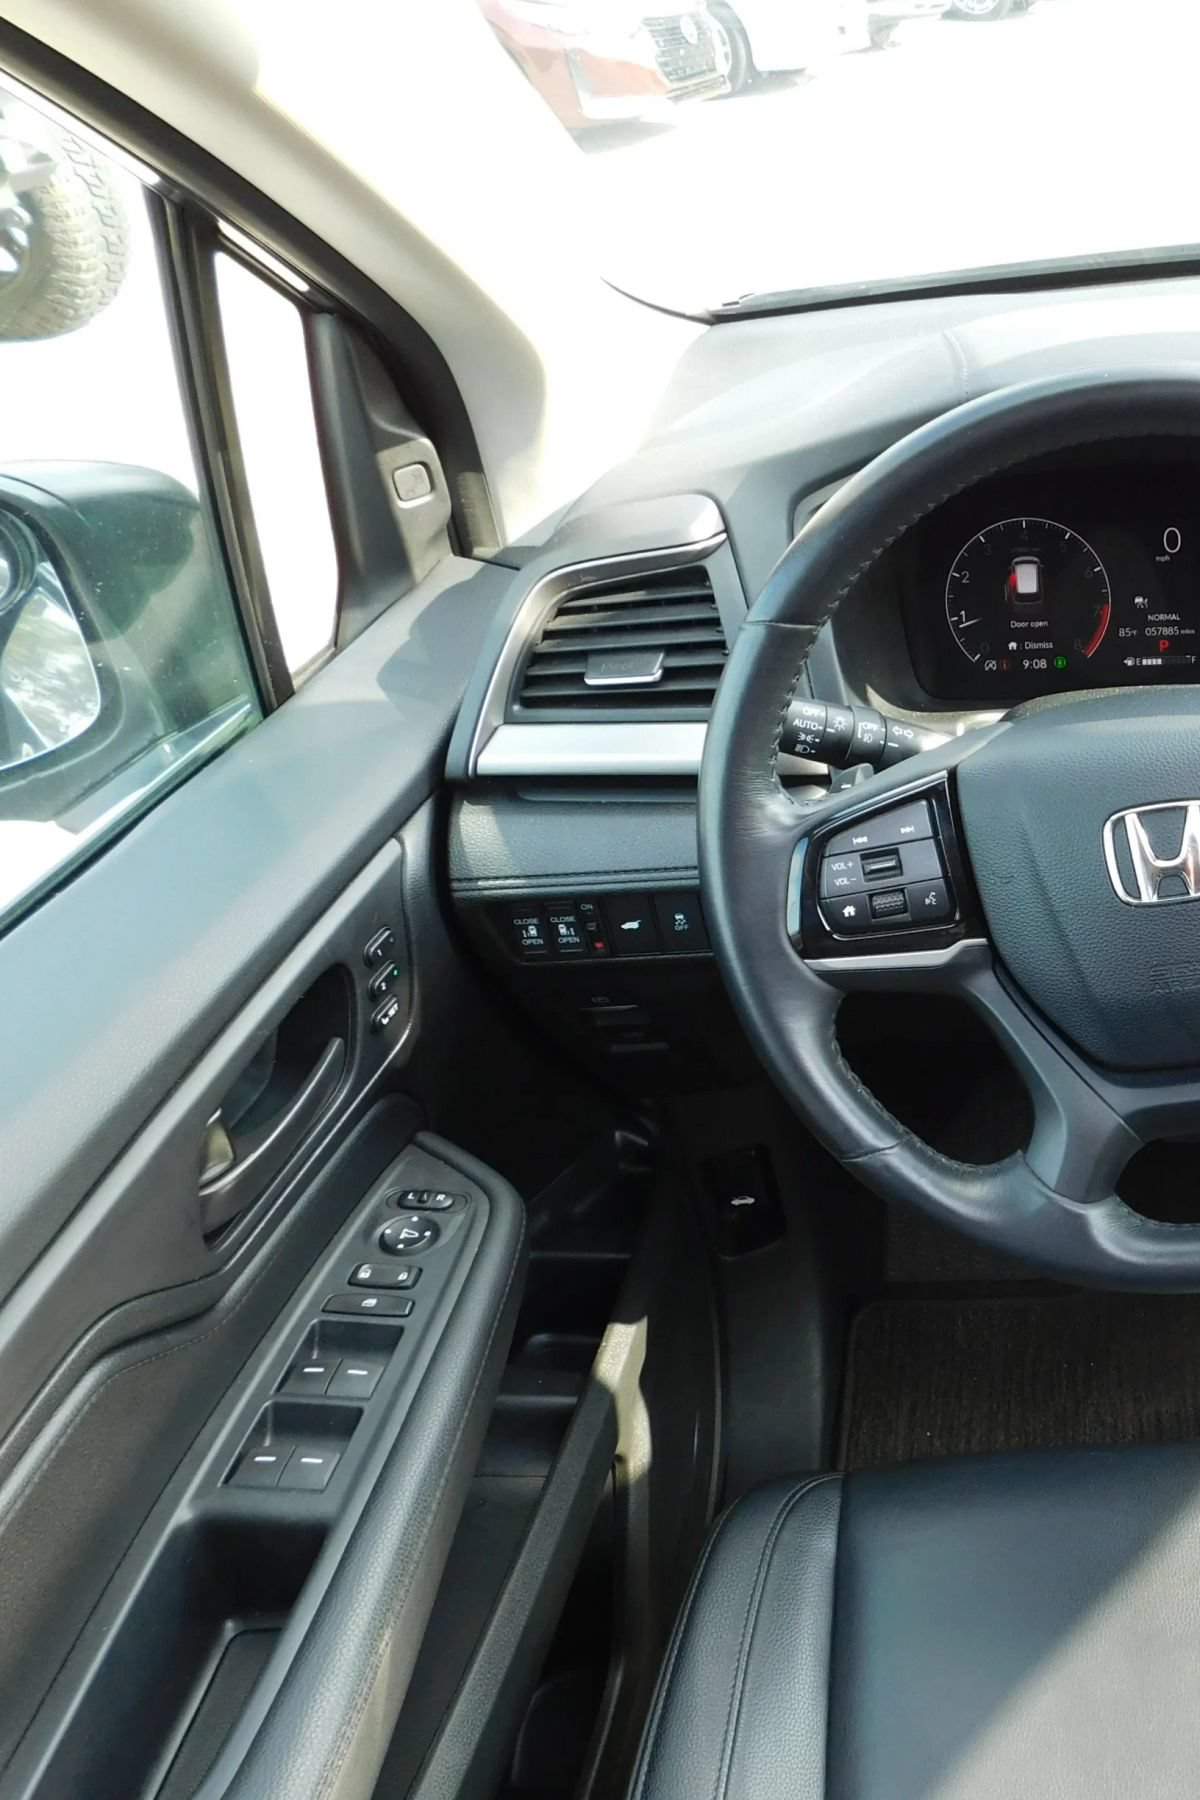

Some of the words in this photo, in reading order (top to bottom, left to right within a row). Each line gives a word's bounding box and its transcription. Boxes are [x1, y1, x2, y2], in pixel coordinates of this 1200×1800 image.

[1163, 527, 1182, 553] 0
[962, 571, 970, 583] 2
[1084, 566, 1094, 578] 6
[960, 610, 966, 622] 1
[1145, 626, 1180, 636] 057885
[1024, 642, 1054, 650] Dismiss
[1160, 640, 1168, 652] P
[1022, 658, 1047, 670] 9:08
[1136, 658, 1142, 666] E
[1192, 656, 1196, 664] F
[802, 708, 820, 717] OFF
[793, 719, 818, 730] AUTO
[863, 722, 879, 730] OFF
[558, 936, 580, 944] OPEN
[408, 1192, 414, 1200] L
